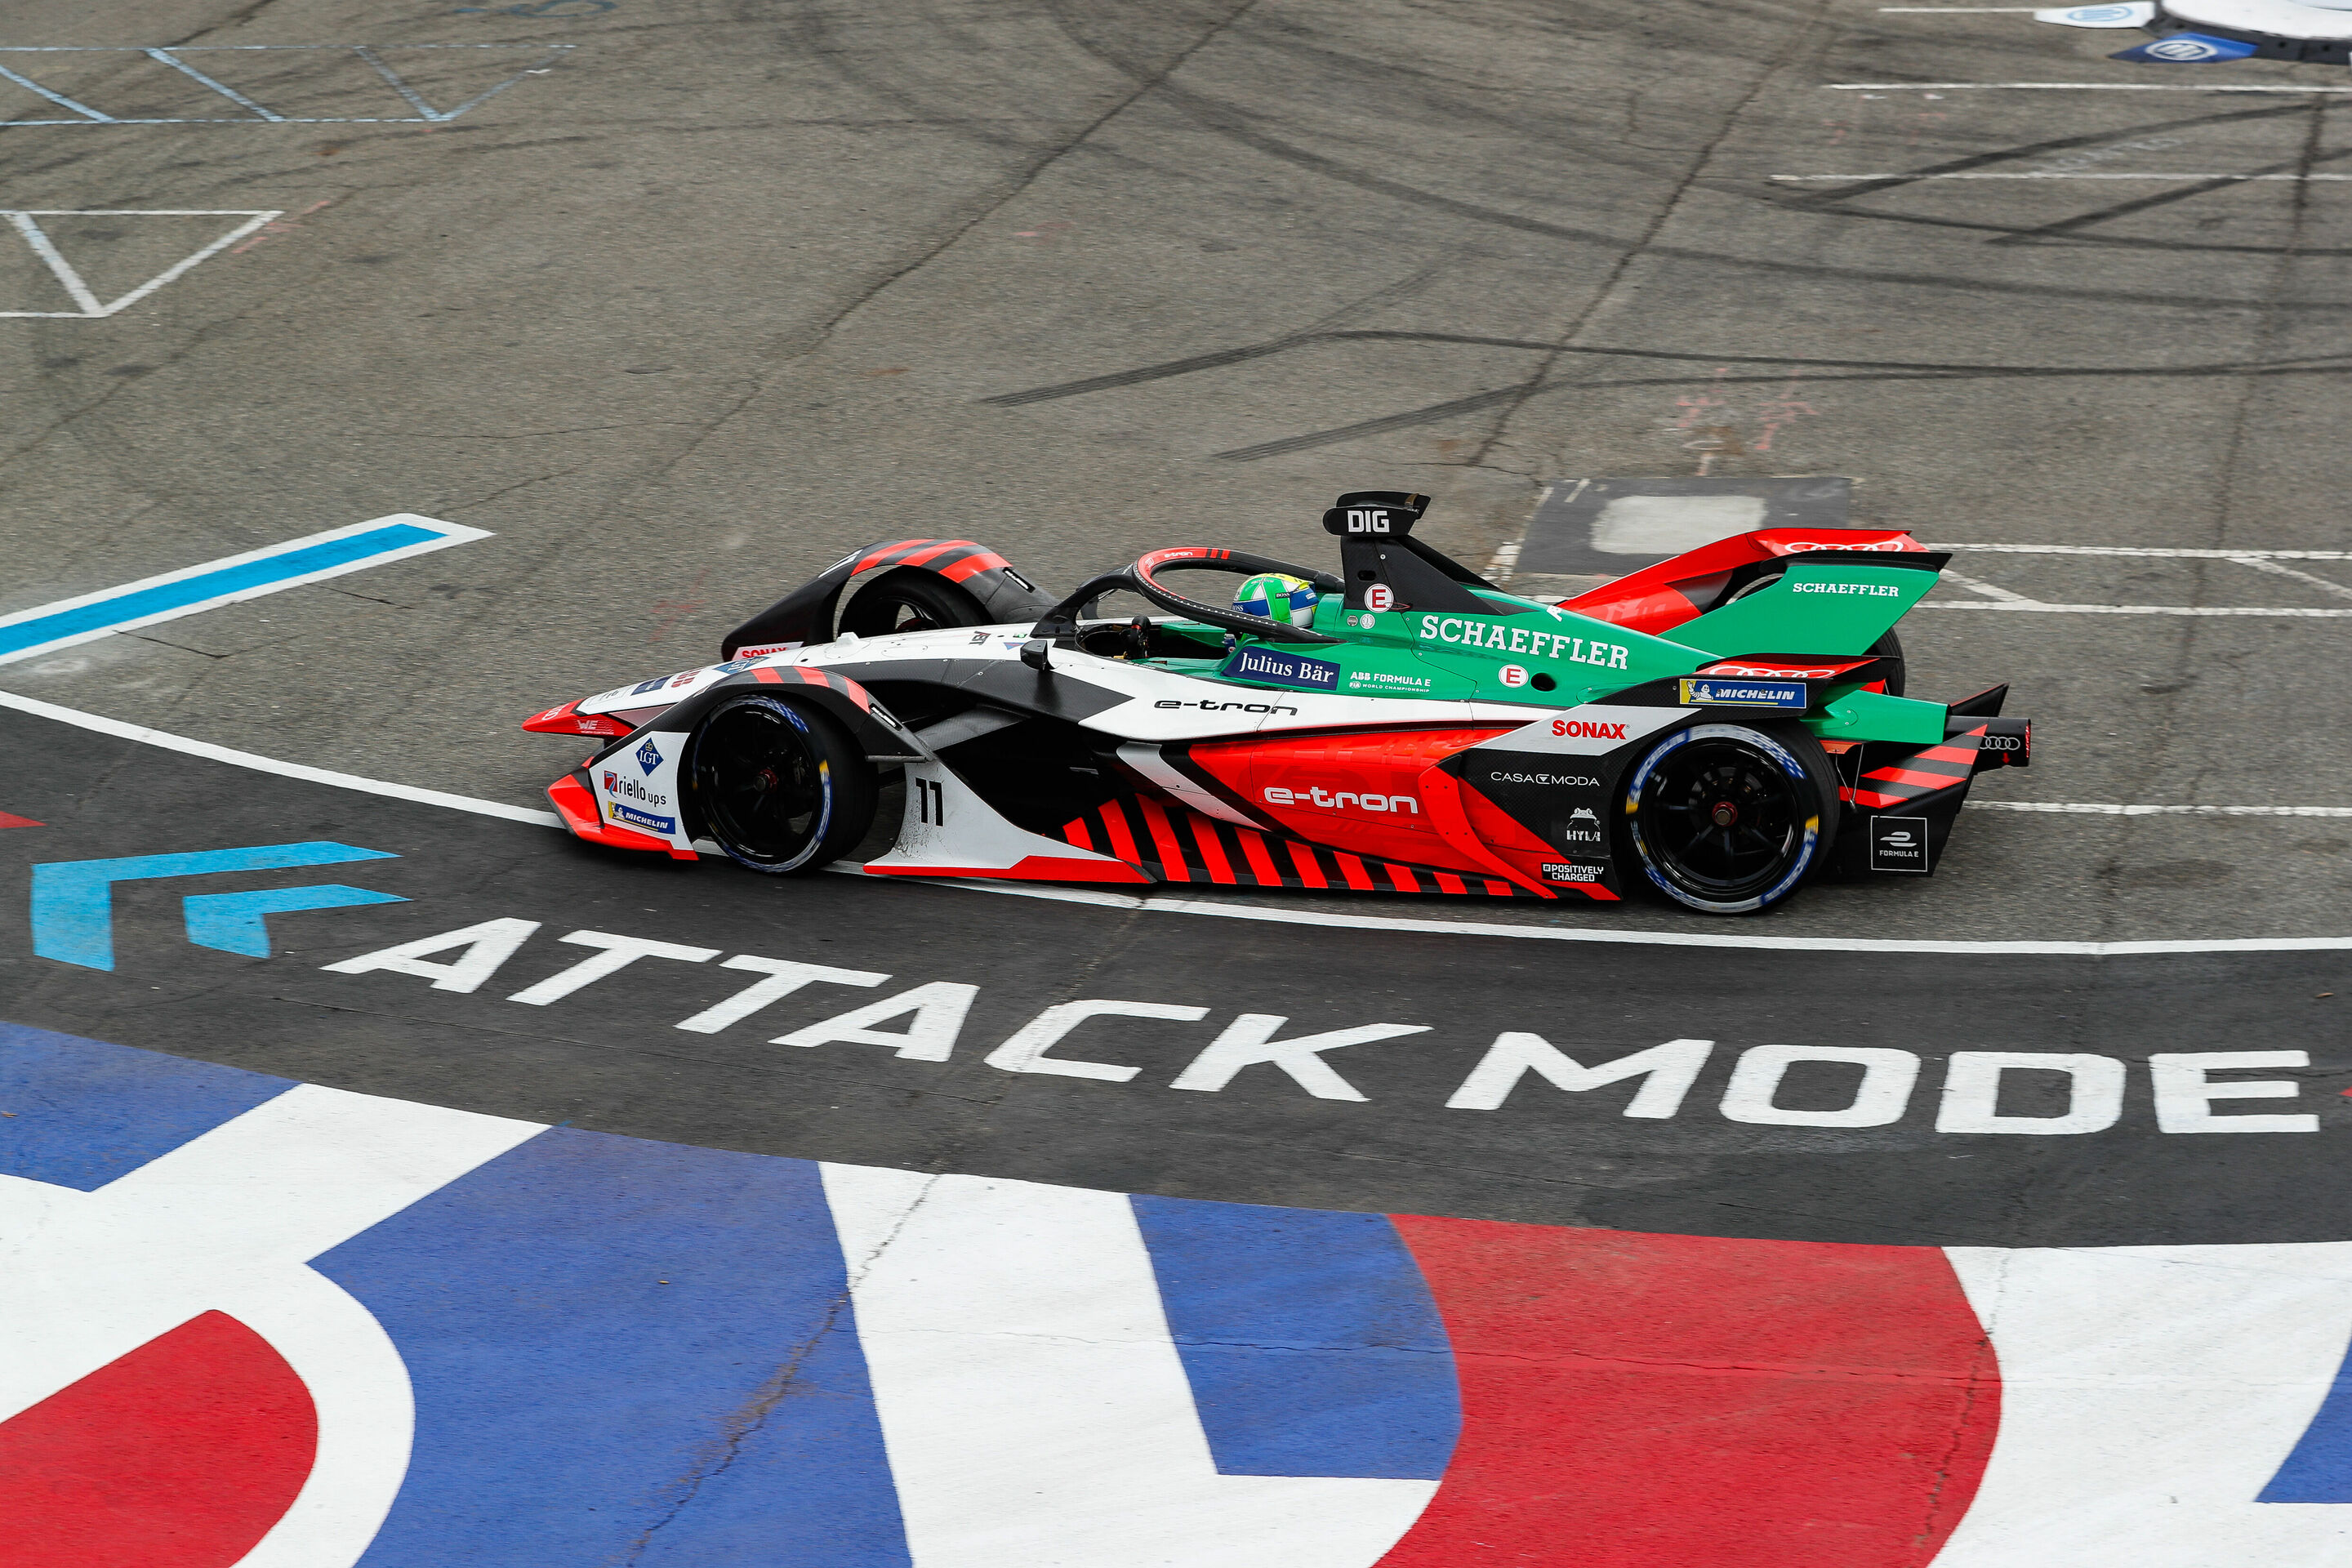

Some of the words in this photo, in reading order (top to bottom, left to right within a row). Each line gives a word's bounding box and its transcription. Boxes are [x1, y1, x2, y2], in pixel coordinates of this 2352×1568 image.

[1348, 510, 1390, 532] DIG
[1793, 582, 1900, 597] SCHAEFFLER
[1371, 589, 1387, 608] E
[1420, 615, 1629, 670] SCHAEFFLER
[1240, 653, 1293, 677] Julius
[1298, 662, 1334, 683] Bär
[1505, 668, 1521, 684] E
[1350, 671, 1371, 681] ABB
[1374, 673, 1423, 686] FORMULA
[1424, 679, 1432, 687] E
[1716, 688, 1795, 701] MICHELIN
[1154, 699, 1298, 716] e-tron
[1552, 719, 1627, 740] SONAX
[639, 750, 659, 764] LGT
[1490, 772, 1535, 784] CASA
[1551, 777, 1601, 786] MODA
[618, 776, 646, 800] riello
[648, 793, 666, 808] ups
[1263, 786, 1419, 814] e-tron
[915, 777, 945, 827] 11
[626, 812, 668, 829] MICHELIN
[1879, 849, 1913, 858] FORMULA
[1552, 872, 1595, 882] CHARGED
[319, 917, 1435, 1102] ATTACK
[1445, 1031, 2320, 1134] MODE
